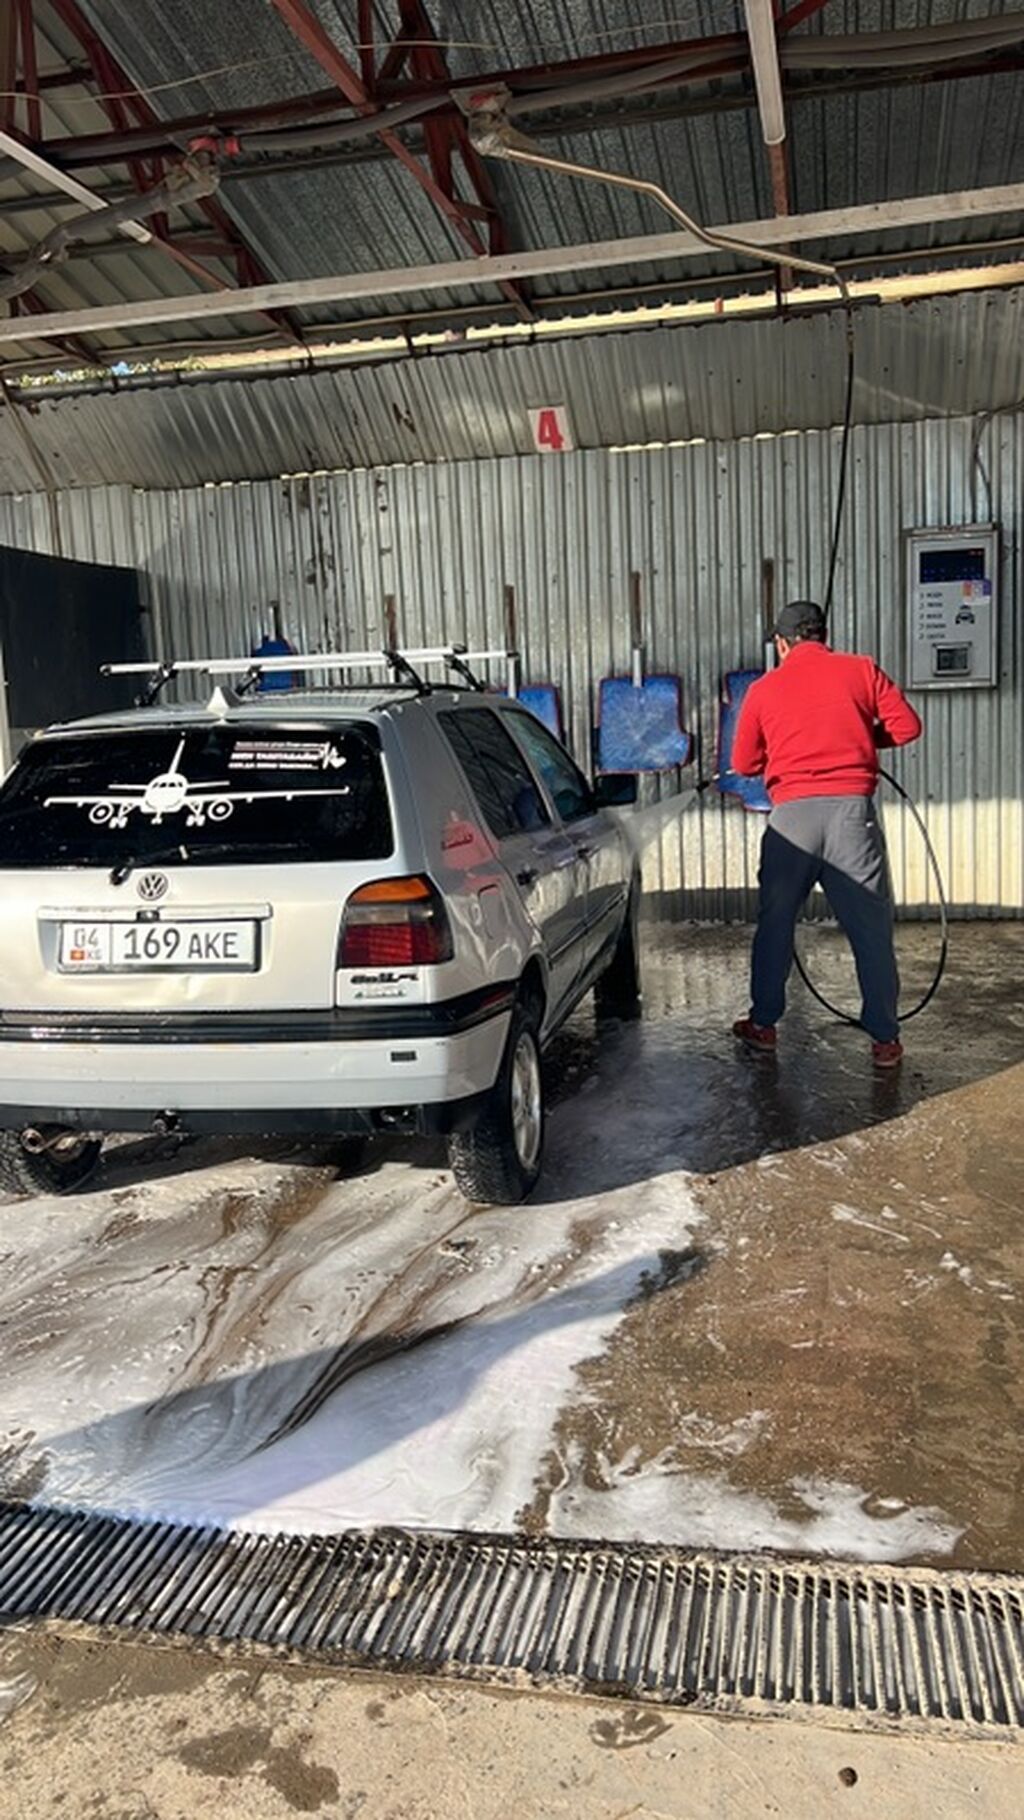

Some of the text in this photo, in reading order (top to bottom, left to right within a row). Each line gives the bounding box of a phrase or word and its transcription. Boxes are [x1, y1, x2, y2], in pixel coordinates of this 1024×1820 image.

[539, 410, 564, 450] 4
[137, 871, 169, 901] VW
[74, 927, 239, 959] 04 169 AKE
